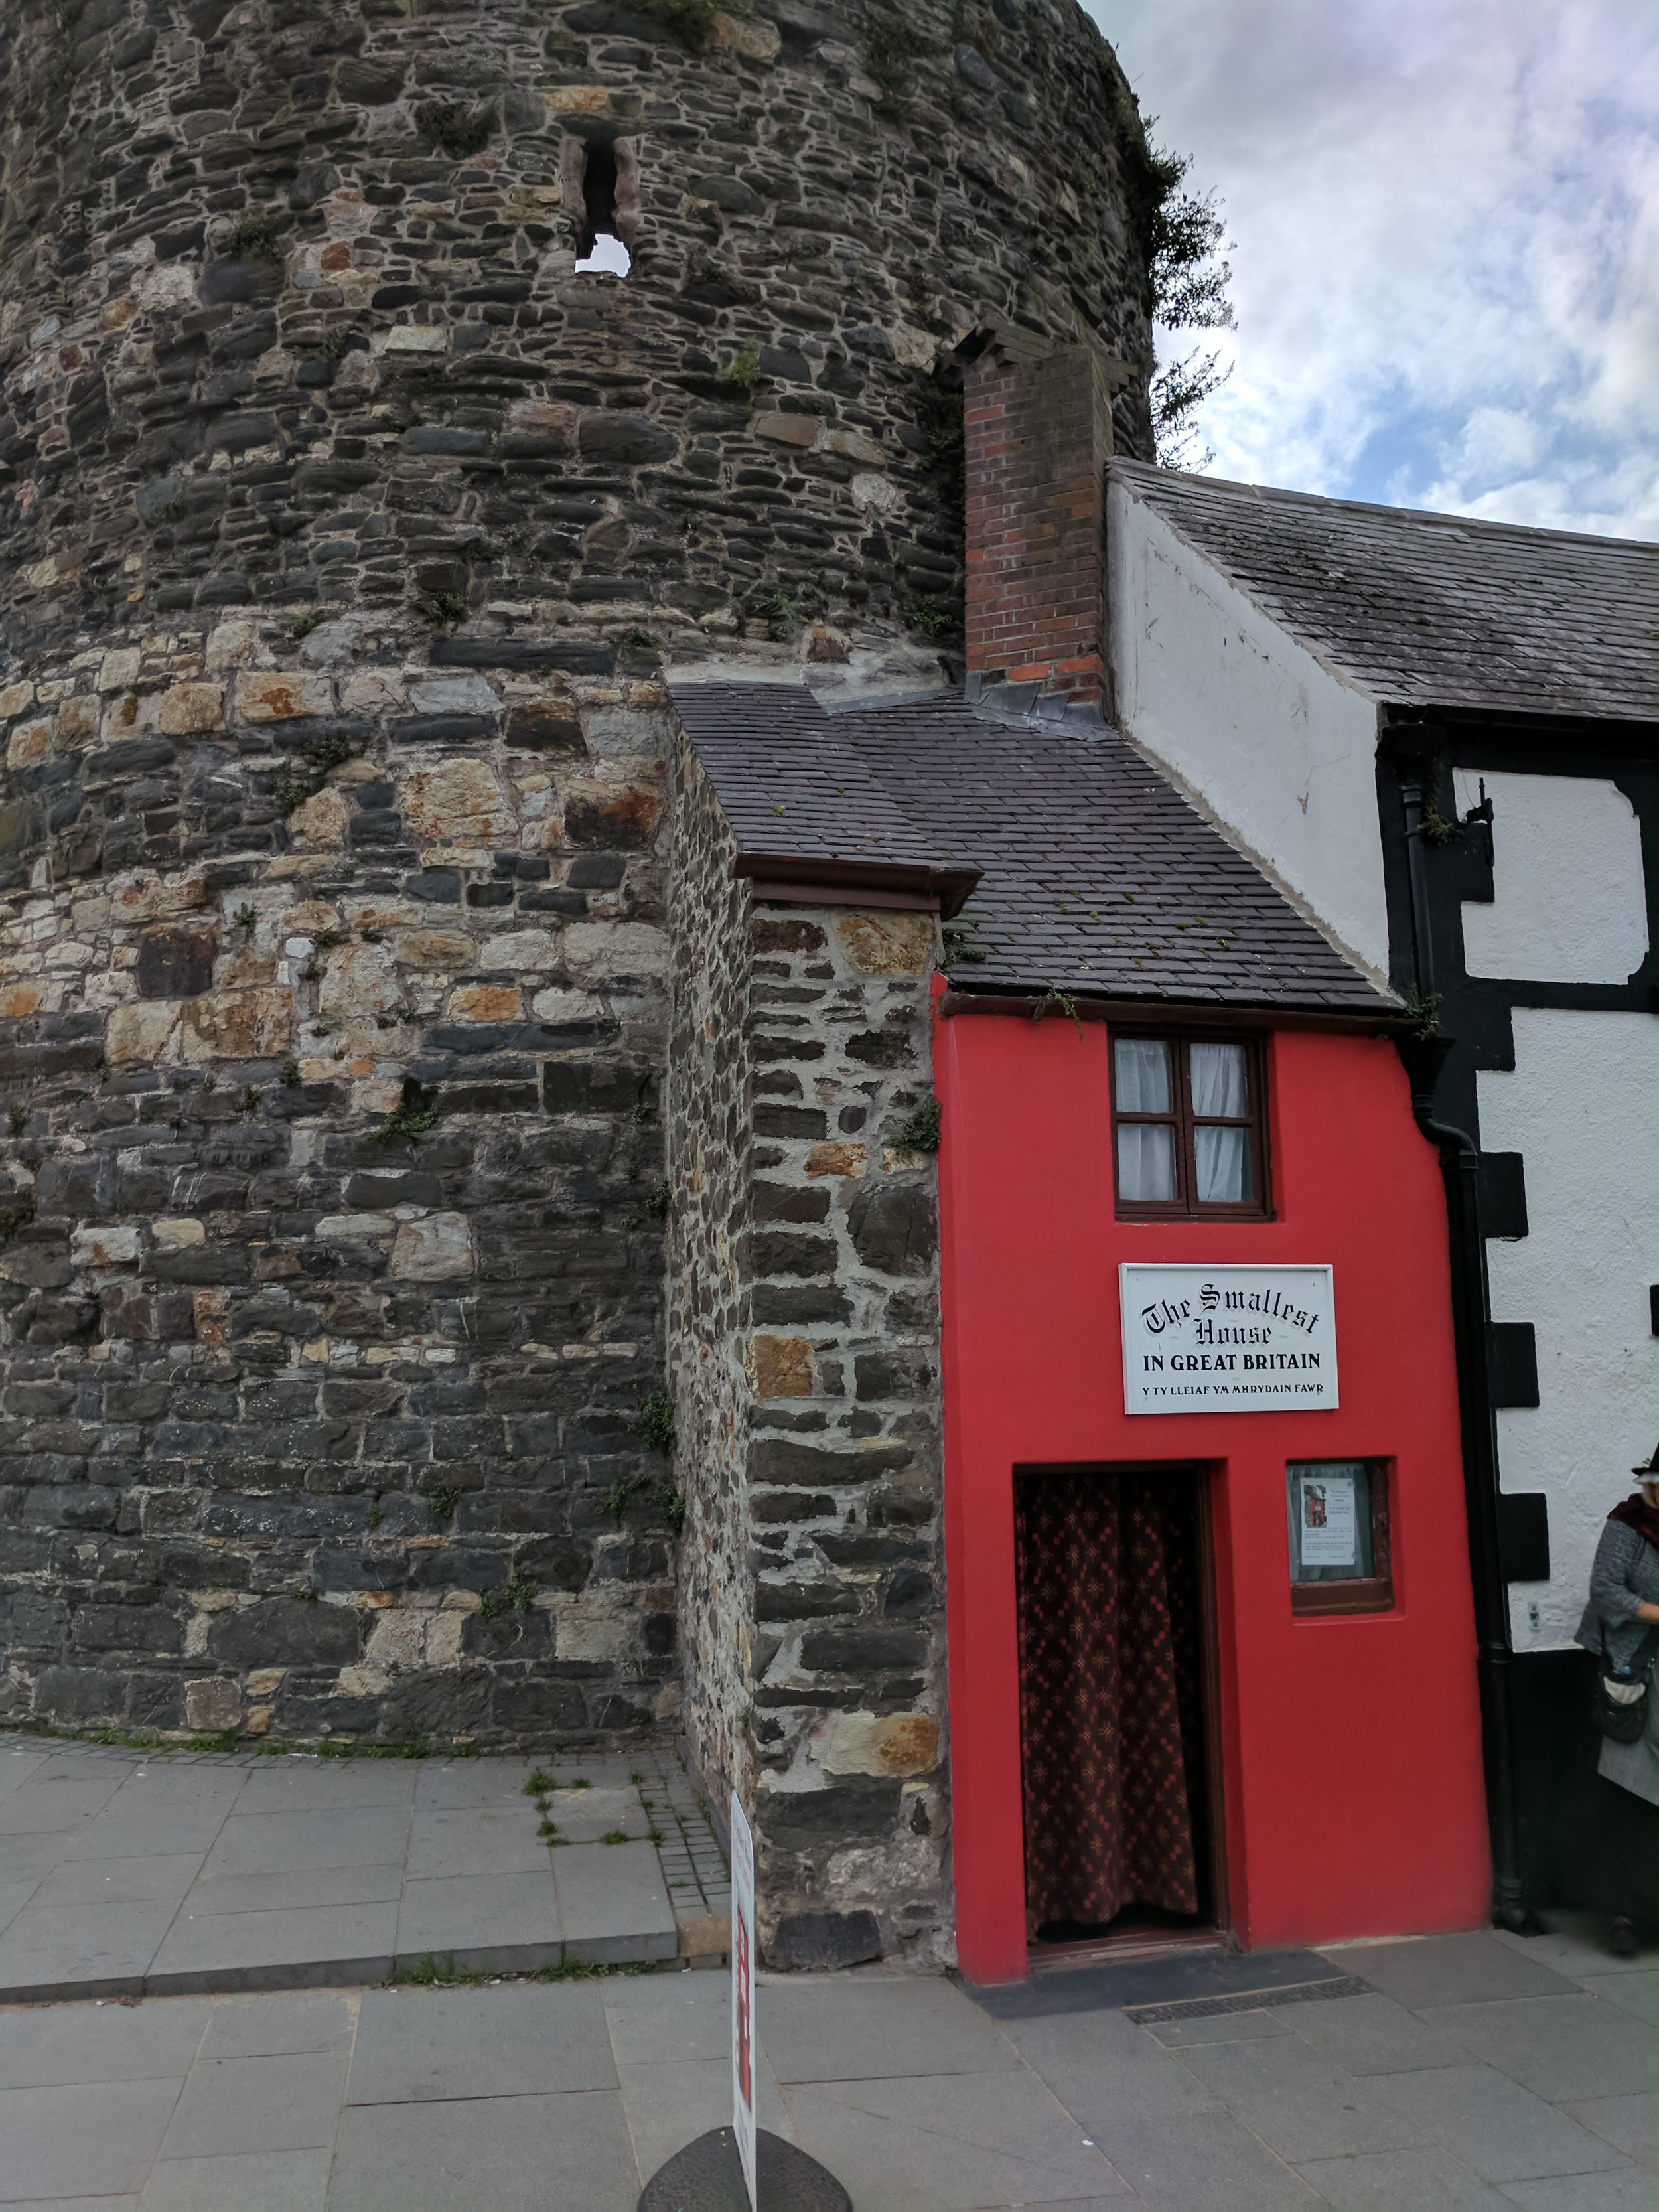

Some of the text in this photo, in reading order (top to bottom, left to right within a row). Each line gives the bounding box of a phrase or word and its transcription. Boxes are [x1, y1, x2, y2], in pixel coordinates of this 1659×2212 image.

[1141, 1283, 1319, 1334] The Smallest
[1193, 1317, 1272, 1345] House
[1143, 1353, 1320, 1372] IN GREAT BRITAIN
[1142, 1387, 1149, 1396] Y
[1171, 1386, 1210, 1395] LLEIAF
[1212, 1386, 1229, 1394] YM
[1232, 1384, 1291, 1394] MHRYDAIN
[1295, 1384, 1323, 1393] FAWR
